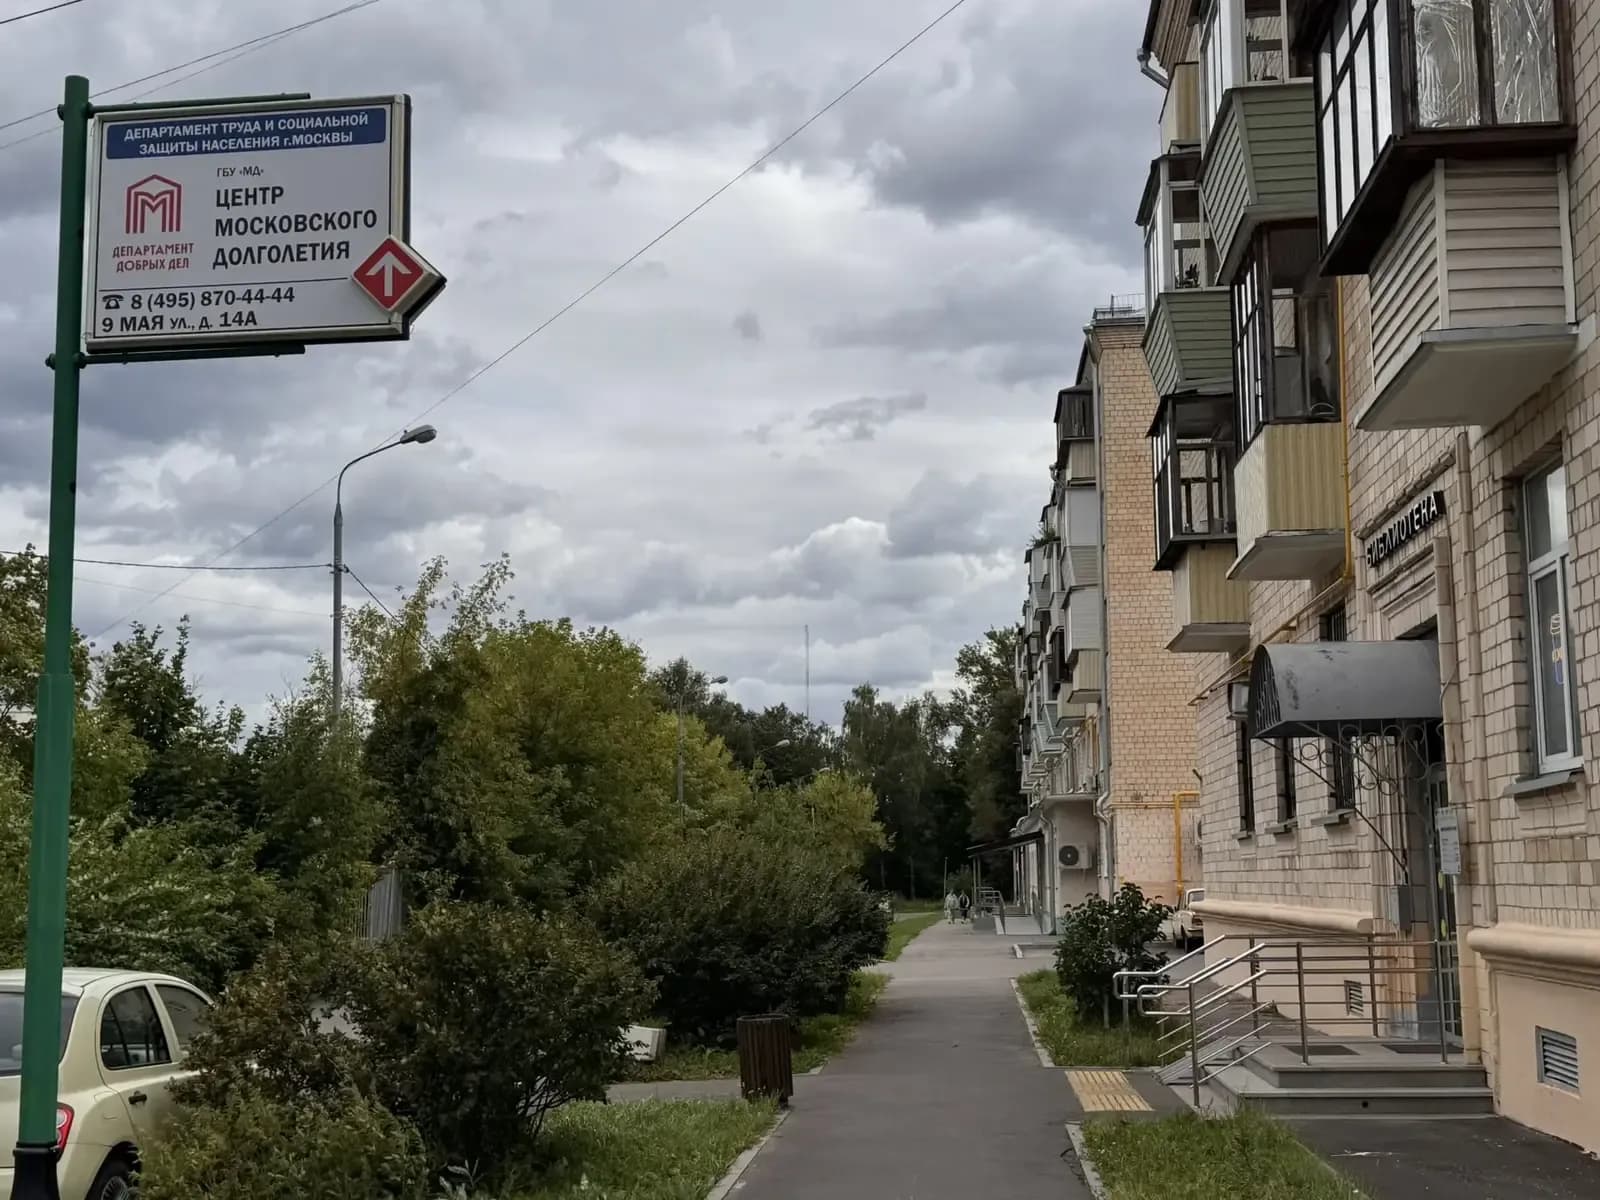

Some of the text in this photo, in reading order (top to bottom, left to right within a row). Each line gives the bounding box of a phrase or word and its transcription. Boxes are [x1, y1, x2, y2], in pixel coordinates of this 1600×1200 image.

[124, 112, 368, 142] ДЕПАРТАМЕНТ ТРУДА И СОЦИАЛЬНОЙ
[139, 140, 198, 155] ЗАЩИТЫ
[202, 136, 280, 151] НАСЕЛЕНИЯ
[216, 167, 236, 178] ГБУ
[216, 186, 284, 210] ЦЕНТР
[215, 209, 378, 237] МОСКОВСКОГО
[112, 242, 194, 259] ДЕПАРТАМЕНТ
[212, 241, 350, 270] ДОЛГОЛЕТИЯ
[116, 257, 190, 273] ДОБРЫХ ДЕЛ
[131, 287, 295, 312] 8 (495) 870-44-44
[102, 317, 114, 333] 9
[120, 315, 164, 332] МАЯ
[219, 310, 258, 328] 14А
[1366, 491, 1447, 569] БИБЛИОТЕКА
